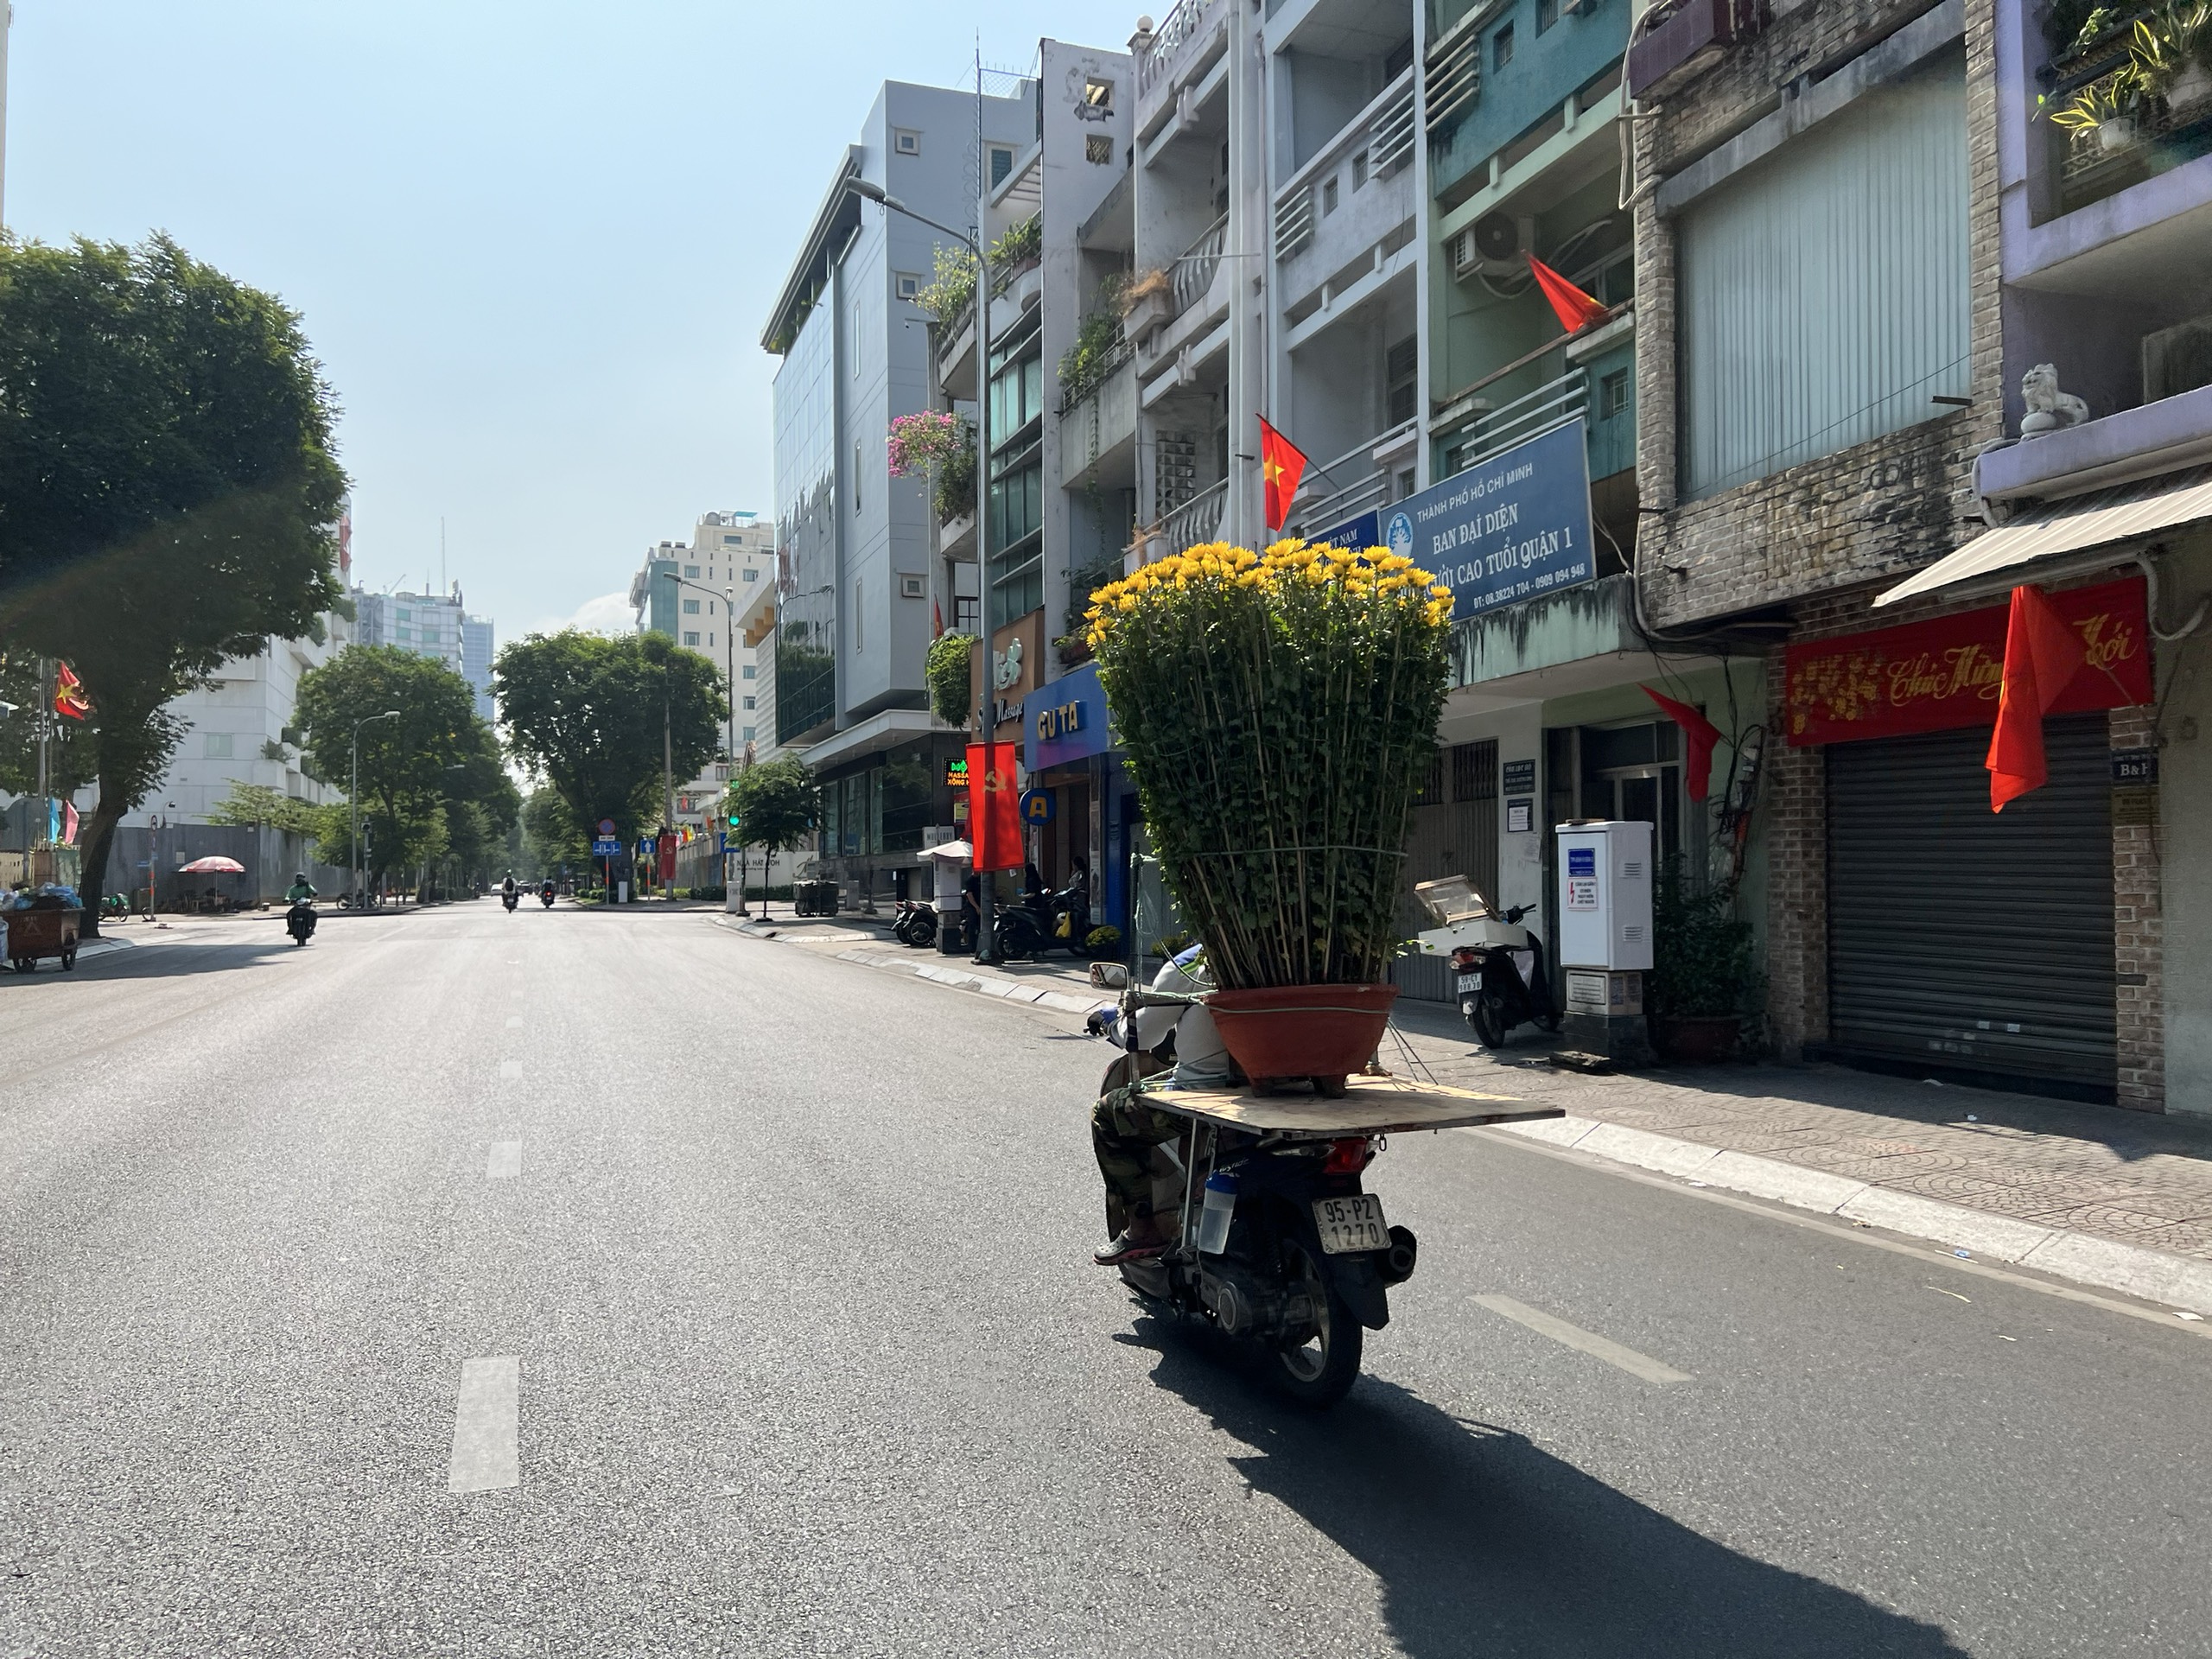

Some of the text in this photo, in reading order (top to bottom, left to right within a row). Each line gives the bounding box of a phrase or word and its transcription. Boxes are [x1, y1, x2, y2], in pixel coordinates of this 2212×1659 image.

[1506, 463, 1533, 486] MINH
[1339, 528, 1357, 546] NAM
[1433, 528, 1457, 555] BAN
[1485, 503, 1518, 535] DIỆN
[1457, 559, 1483, 585] CAO
[1486, 537, 1518, 575] TUỔI
[1520, 530, 1559, 569] QUẬN
[1564, 526, 1573, 548] 1
[1516, 581, 1529, 596] 704
[1325, 1198, 1374, 1223] 95-P2
[1331, 1223, 1380, 1247] 1270
